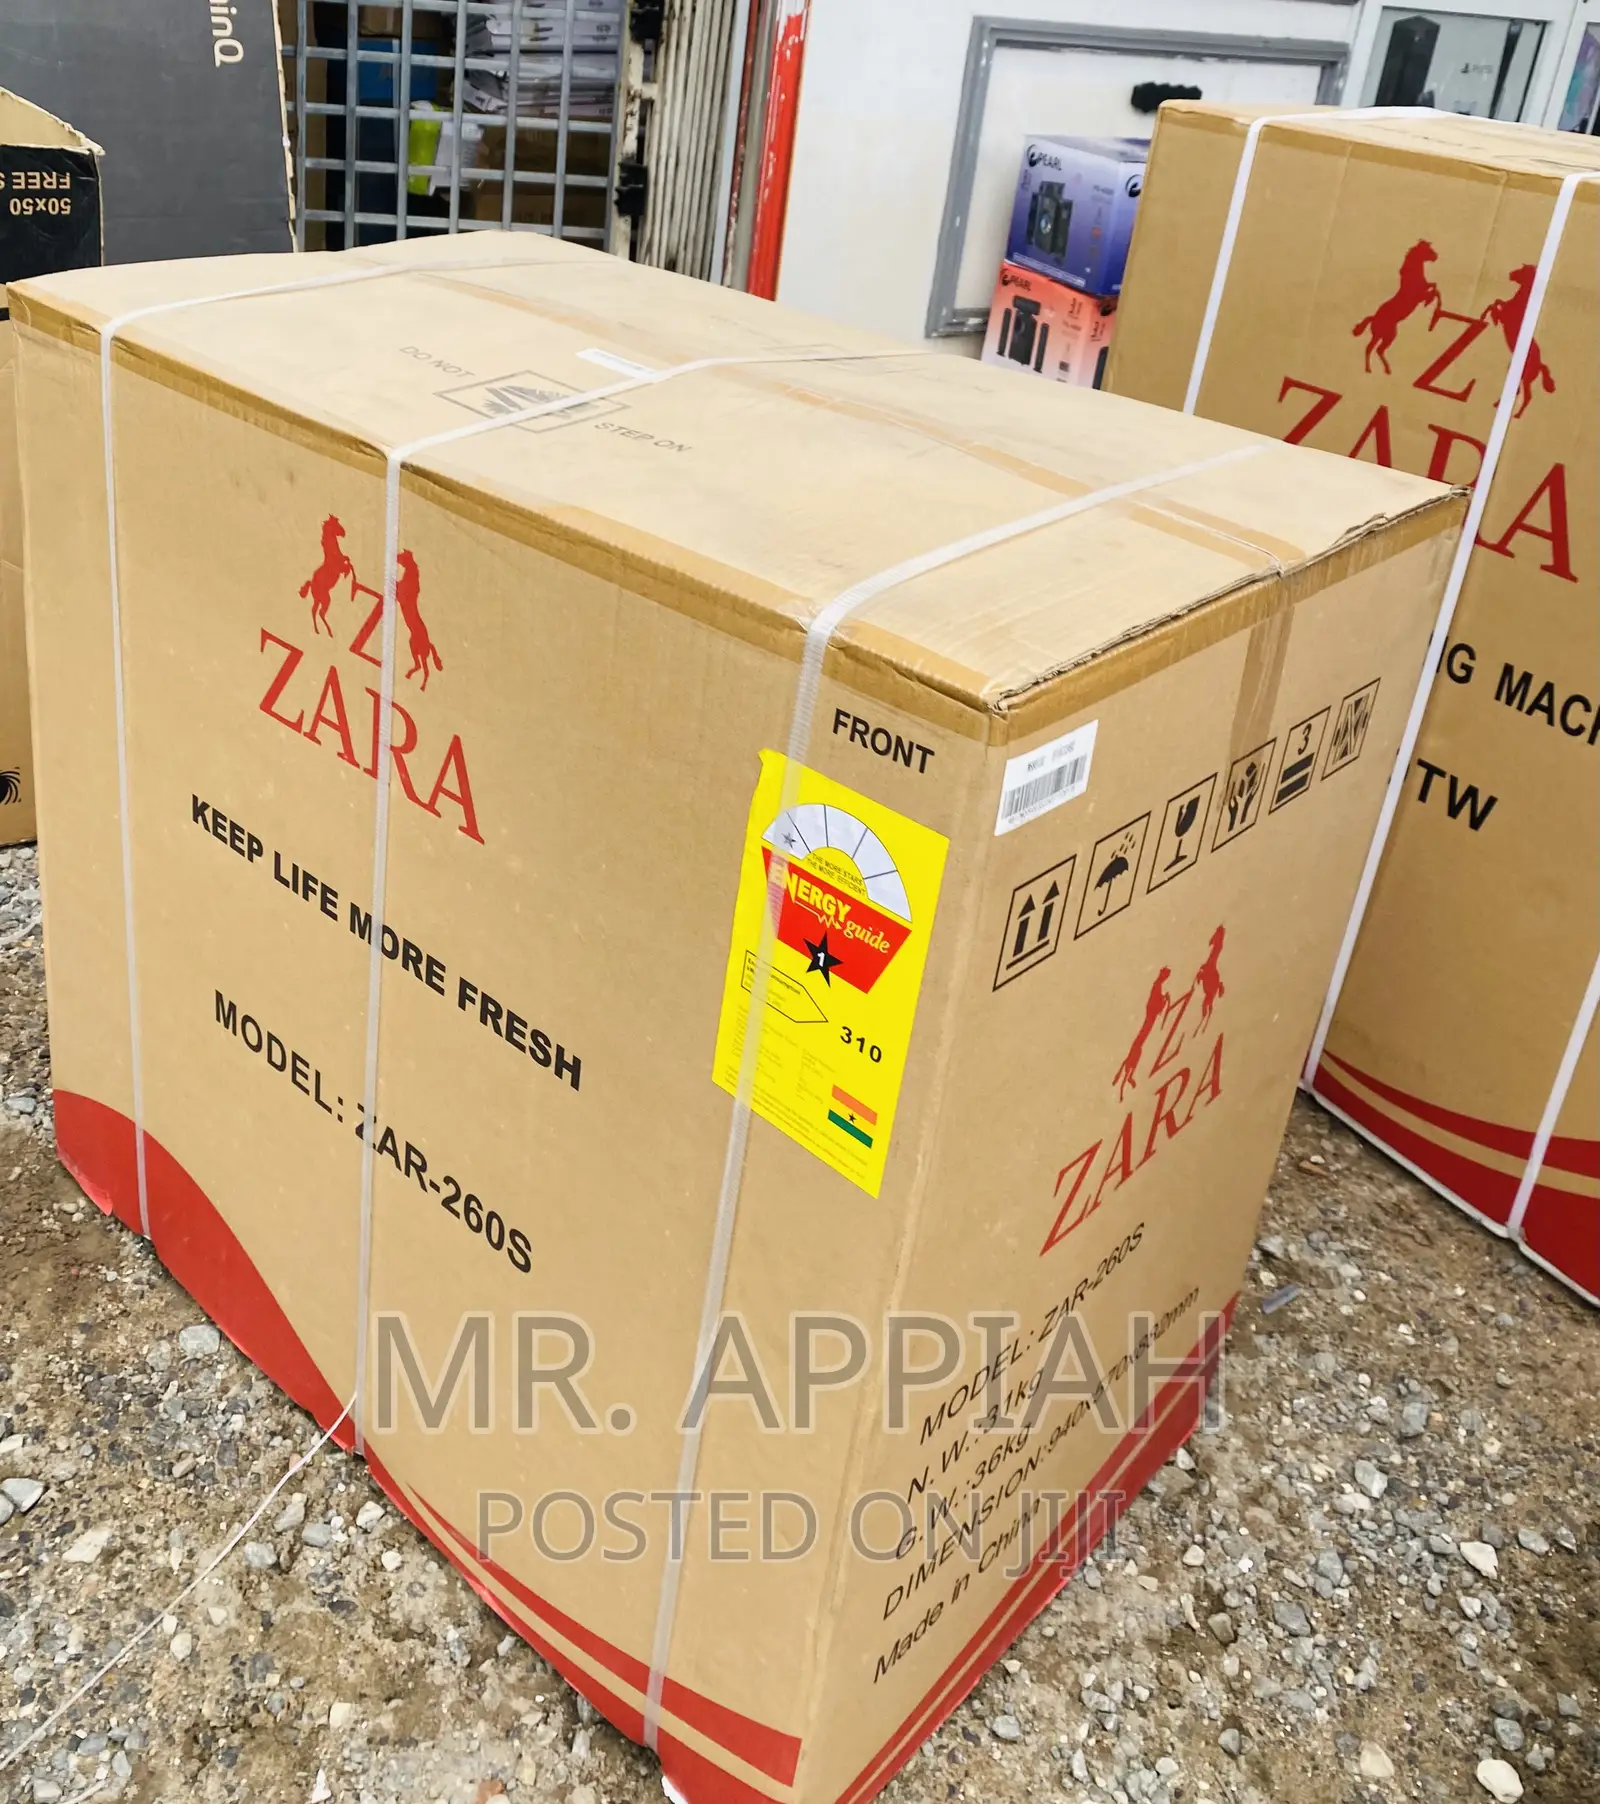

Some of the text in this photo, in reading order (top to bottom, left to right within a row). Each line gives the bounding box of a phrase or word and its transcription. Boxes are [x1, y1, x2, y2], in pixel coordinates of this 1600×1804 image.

[9, 197, 72, 216] 50x50
[11, 171, 72, 190] FREE
[400, 345, 475, 379] DO NOT
[594, 421, 694, 453] STEP ON
[1494, 662, 1600, 746] MAC
[259, 627, 485, 846] ZARA
[832, 707, 935, 774] FRONT
[770, 861, 851, 922] ENERGY
[192, 793, 582, 1091] KEEP LIFE MORE FRESH
[817, 951, 826, 968] 1
[842, 919, 891, 954] guide
[839, 1025, 882, 1064] 310
[215, 989, 532, 1274] MODEL: ZAR-260S
[1039, 1033, 1224, 1257] ZARA
[919, 1221, 1145, 1445] MODEL: ZAR-260S
[873, 1497, 1041, 1685] Made in China
